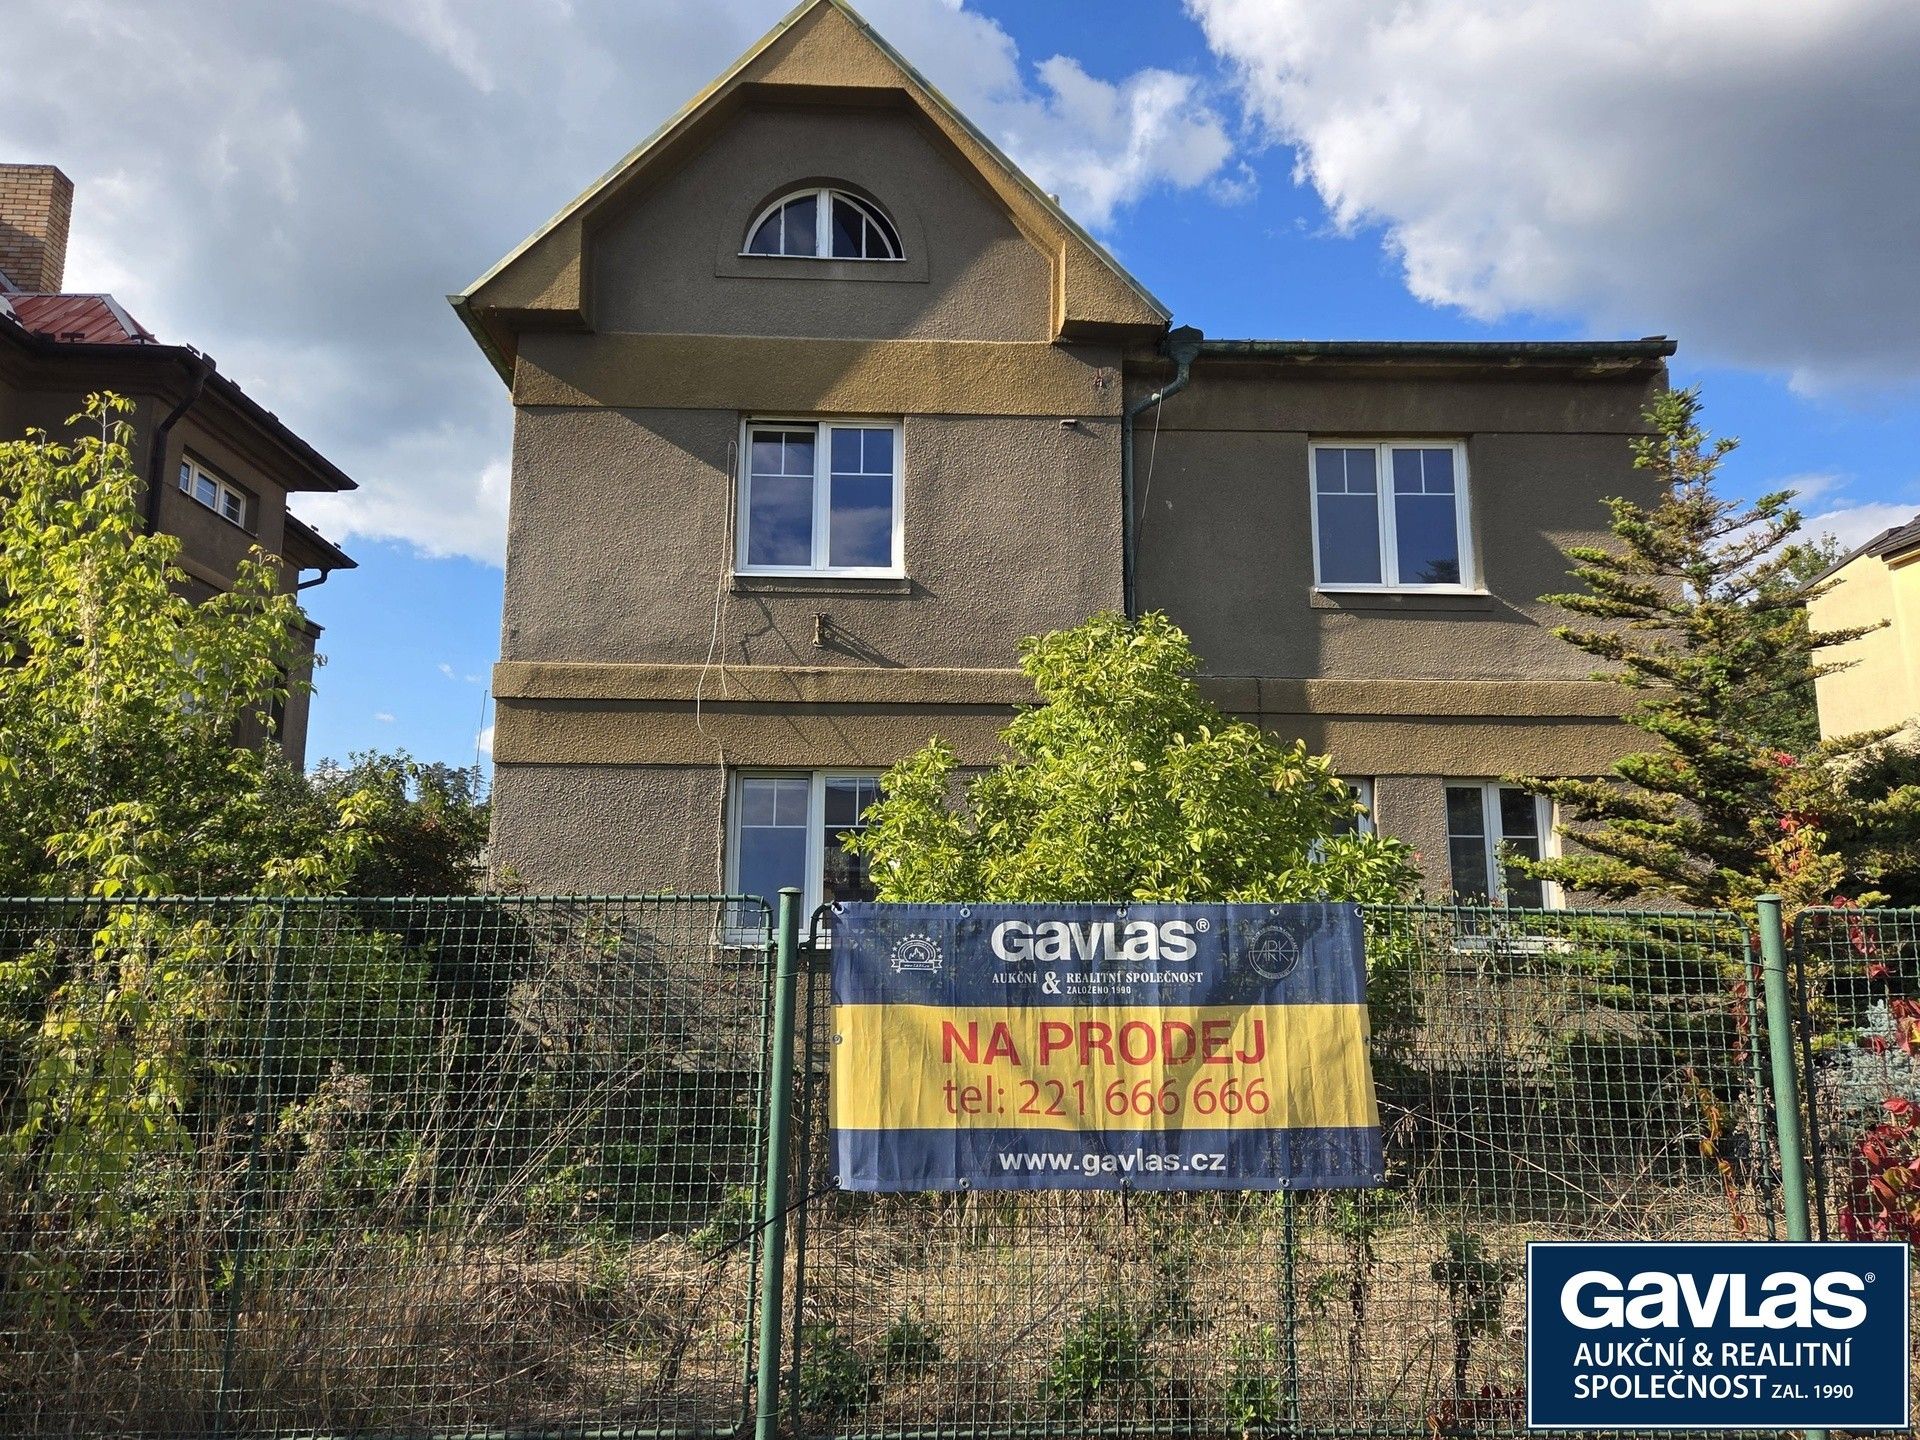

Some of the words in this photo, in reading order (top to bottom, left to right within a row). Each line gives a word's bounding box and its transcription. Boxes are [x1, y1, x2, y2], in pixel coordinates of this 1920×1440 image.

[992, 971, 1037, 984] AUKČNÍ
[1042, 971, 1061, 994] &
[1066, 970, 1121, 983] REALITNÍ
[1125, 970, 1203, 983] SPOLEČNOST
[1066, 984, 1109, 994] ZALOŽENO
[1111, 985, 1131, 994] 1990
[942, 1021, 1021, 1065] NA
[1039, 1020, 1266, 1065] PRODEJ
[943, 1075, 1005, 1114] tel:
[1019, 1078, 1086, 1115] 221
[1105, 1077, 1181, 1115] 666
[1192, 1077, 1270, 1115] 666
[1000, 1147, 1226, 1175] www.gavlas.cz
